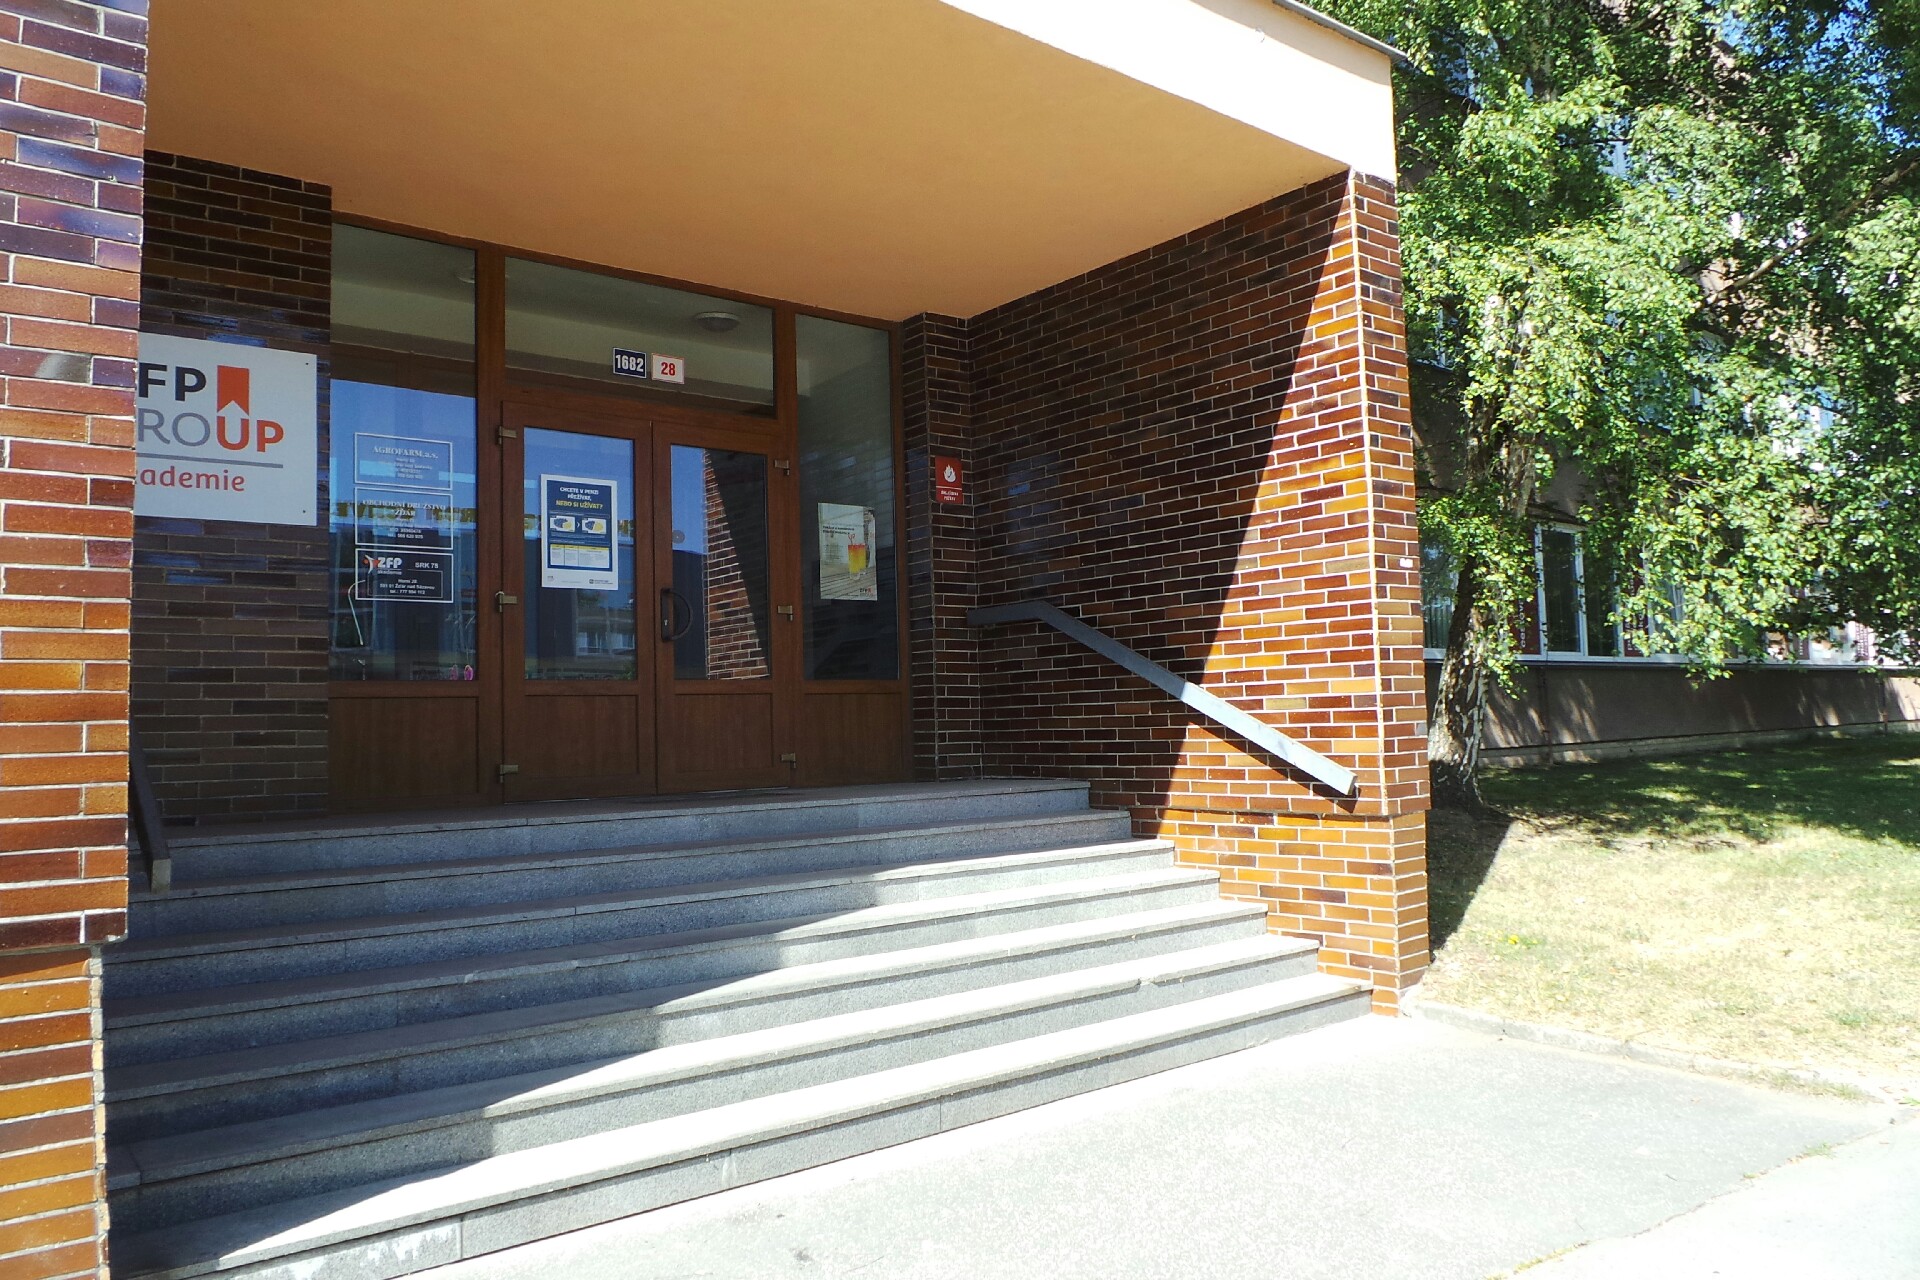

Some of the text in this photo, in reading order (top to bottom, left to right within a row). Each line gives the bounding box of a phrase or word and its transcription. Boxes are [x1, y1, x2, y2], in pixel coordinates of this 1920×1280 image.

[615, 354, 644, 372] 1682
[661, 361, 676, 376] 28
[138, 362, 207, 402] FP
[138, 407, 285, 453] ROUP
[137, 465, 245, 492] ademie
[377, 556, 403, 569] ZFP
